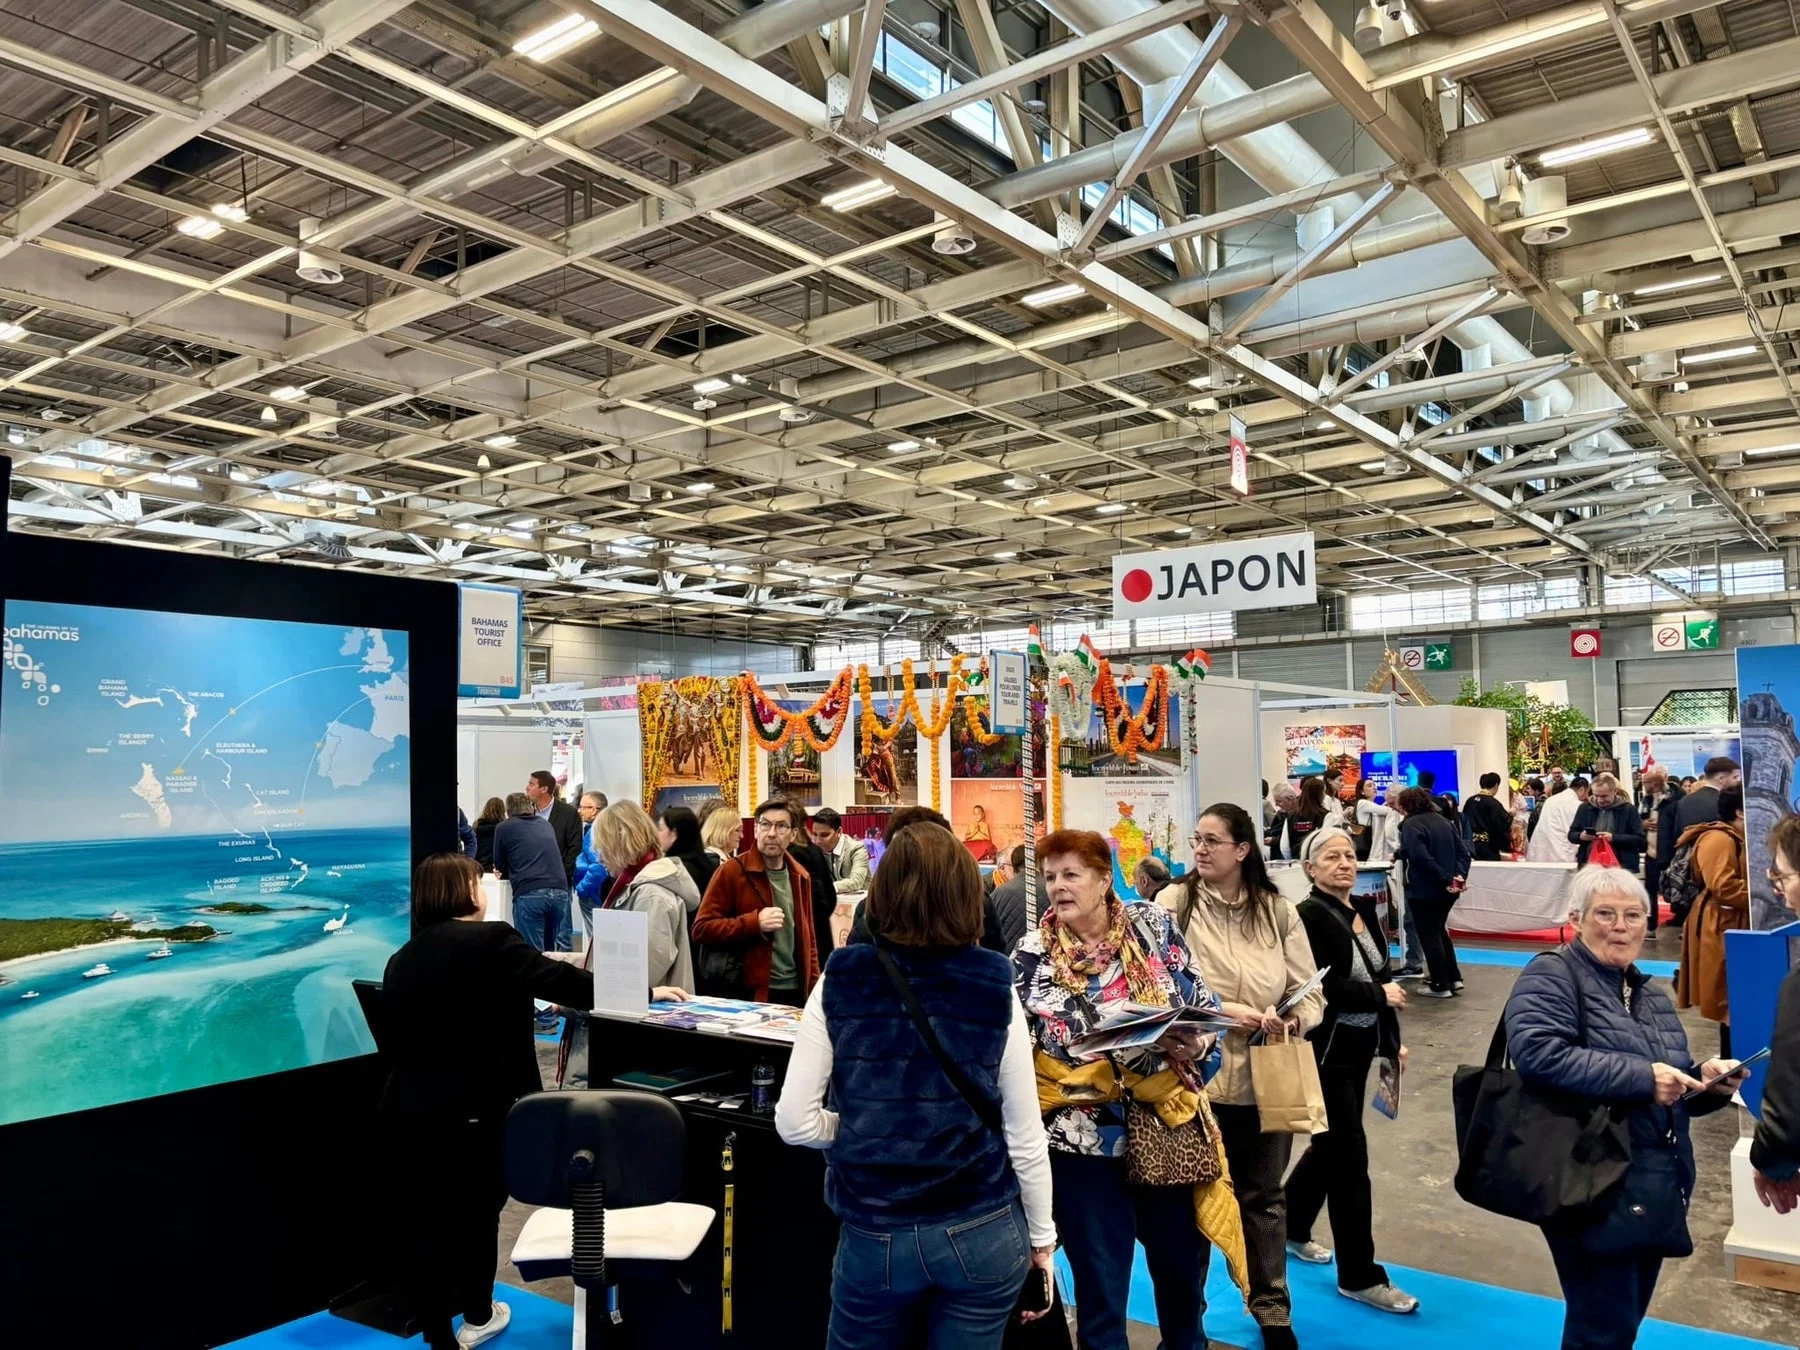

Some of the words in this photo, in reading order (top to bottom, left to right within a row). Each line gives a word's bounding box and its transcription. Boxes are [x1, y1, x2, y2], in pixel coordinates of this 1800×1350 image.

[1157, 550, 1306, 600] JAPON
[471, 617, 508, 628] BAHAMAS
[474, 627, 505, 637] TOURIST
[477, 638, 502, 647] OFFICE
